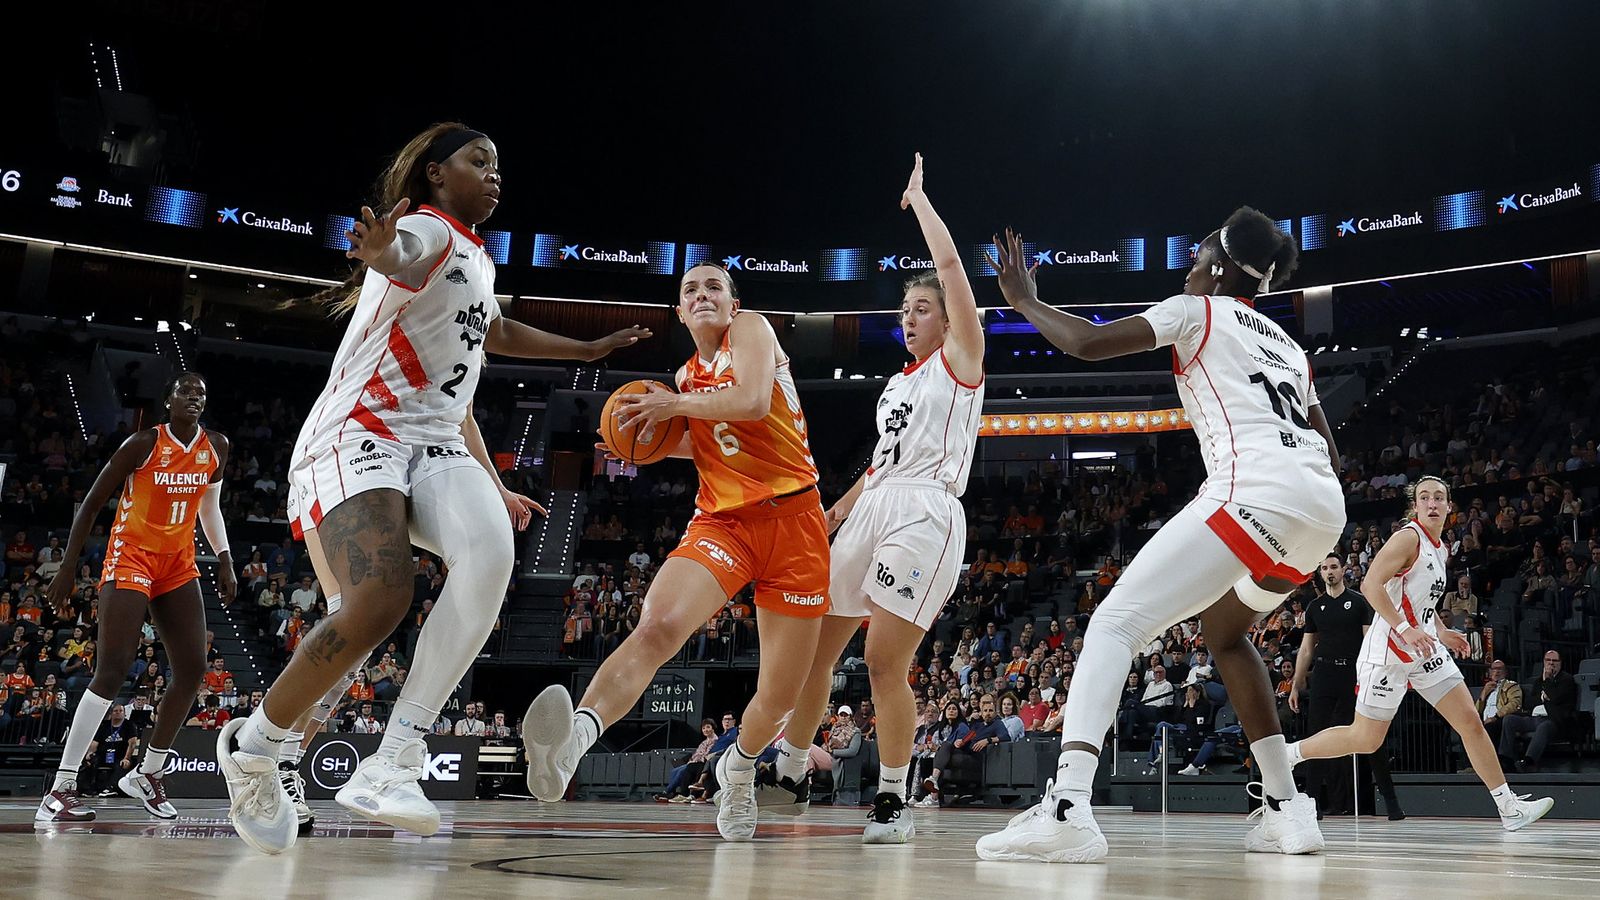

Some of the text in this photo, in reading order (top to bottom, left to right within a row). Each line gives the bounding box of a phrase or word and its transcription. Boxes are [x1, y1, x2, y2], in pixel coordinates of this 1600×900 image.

[0, 169, 21, 192] 6
[1520, 182, 1582, 209] CaixaBank
[241, 211, 313, 236] CaixaBank
[1357, 211, 1423, 233] CaixaBank
[581, 247, 649, 264] CaixaBank
[899, 256, 936, 270] Caixa
[1054, 250, 1119, 265] CaixaBank
[744, 257, 809, 273] CaixaBank
[440, 362, 468, 398] 2
[713, 422, 740, 457] 6
[153, 471, 208, 485] VALENCIA
[166, 486, 198, 494] BASKET
[170, 501, 188, 525] 11
[1250, 518, 1268, 536] NEW
[698, 540, 735, 567] PULEVA
[782, 592, 824, 606] Vitaldin
[650, 700, 694, 713] SALIDA
[162, 755, 216, 775] Midea
[321, 757, 350, 771] SH
